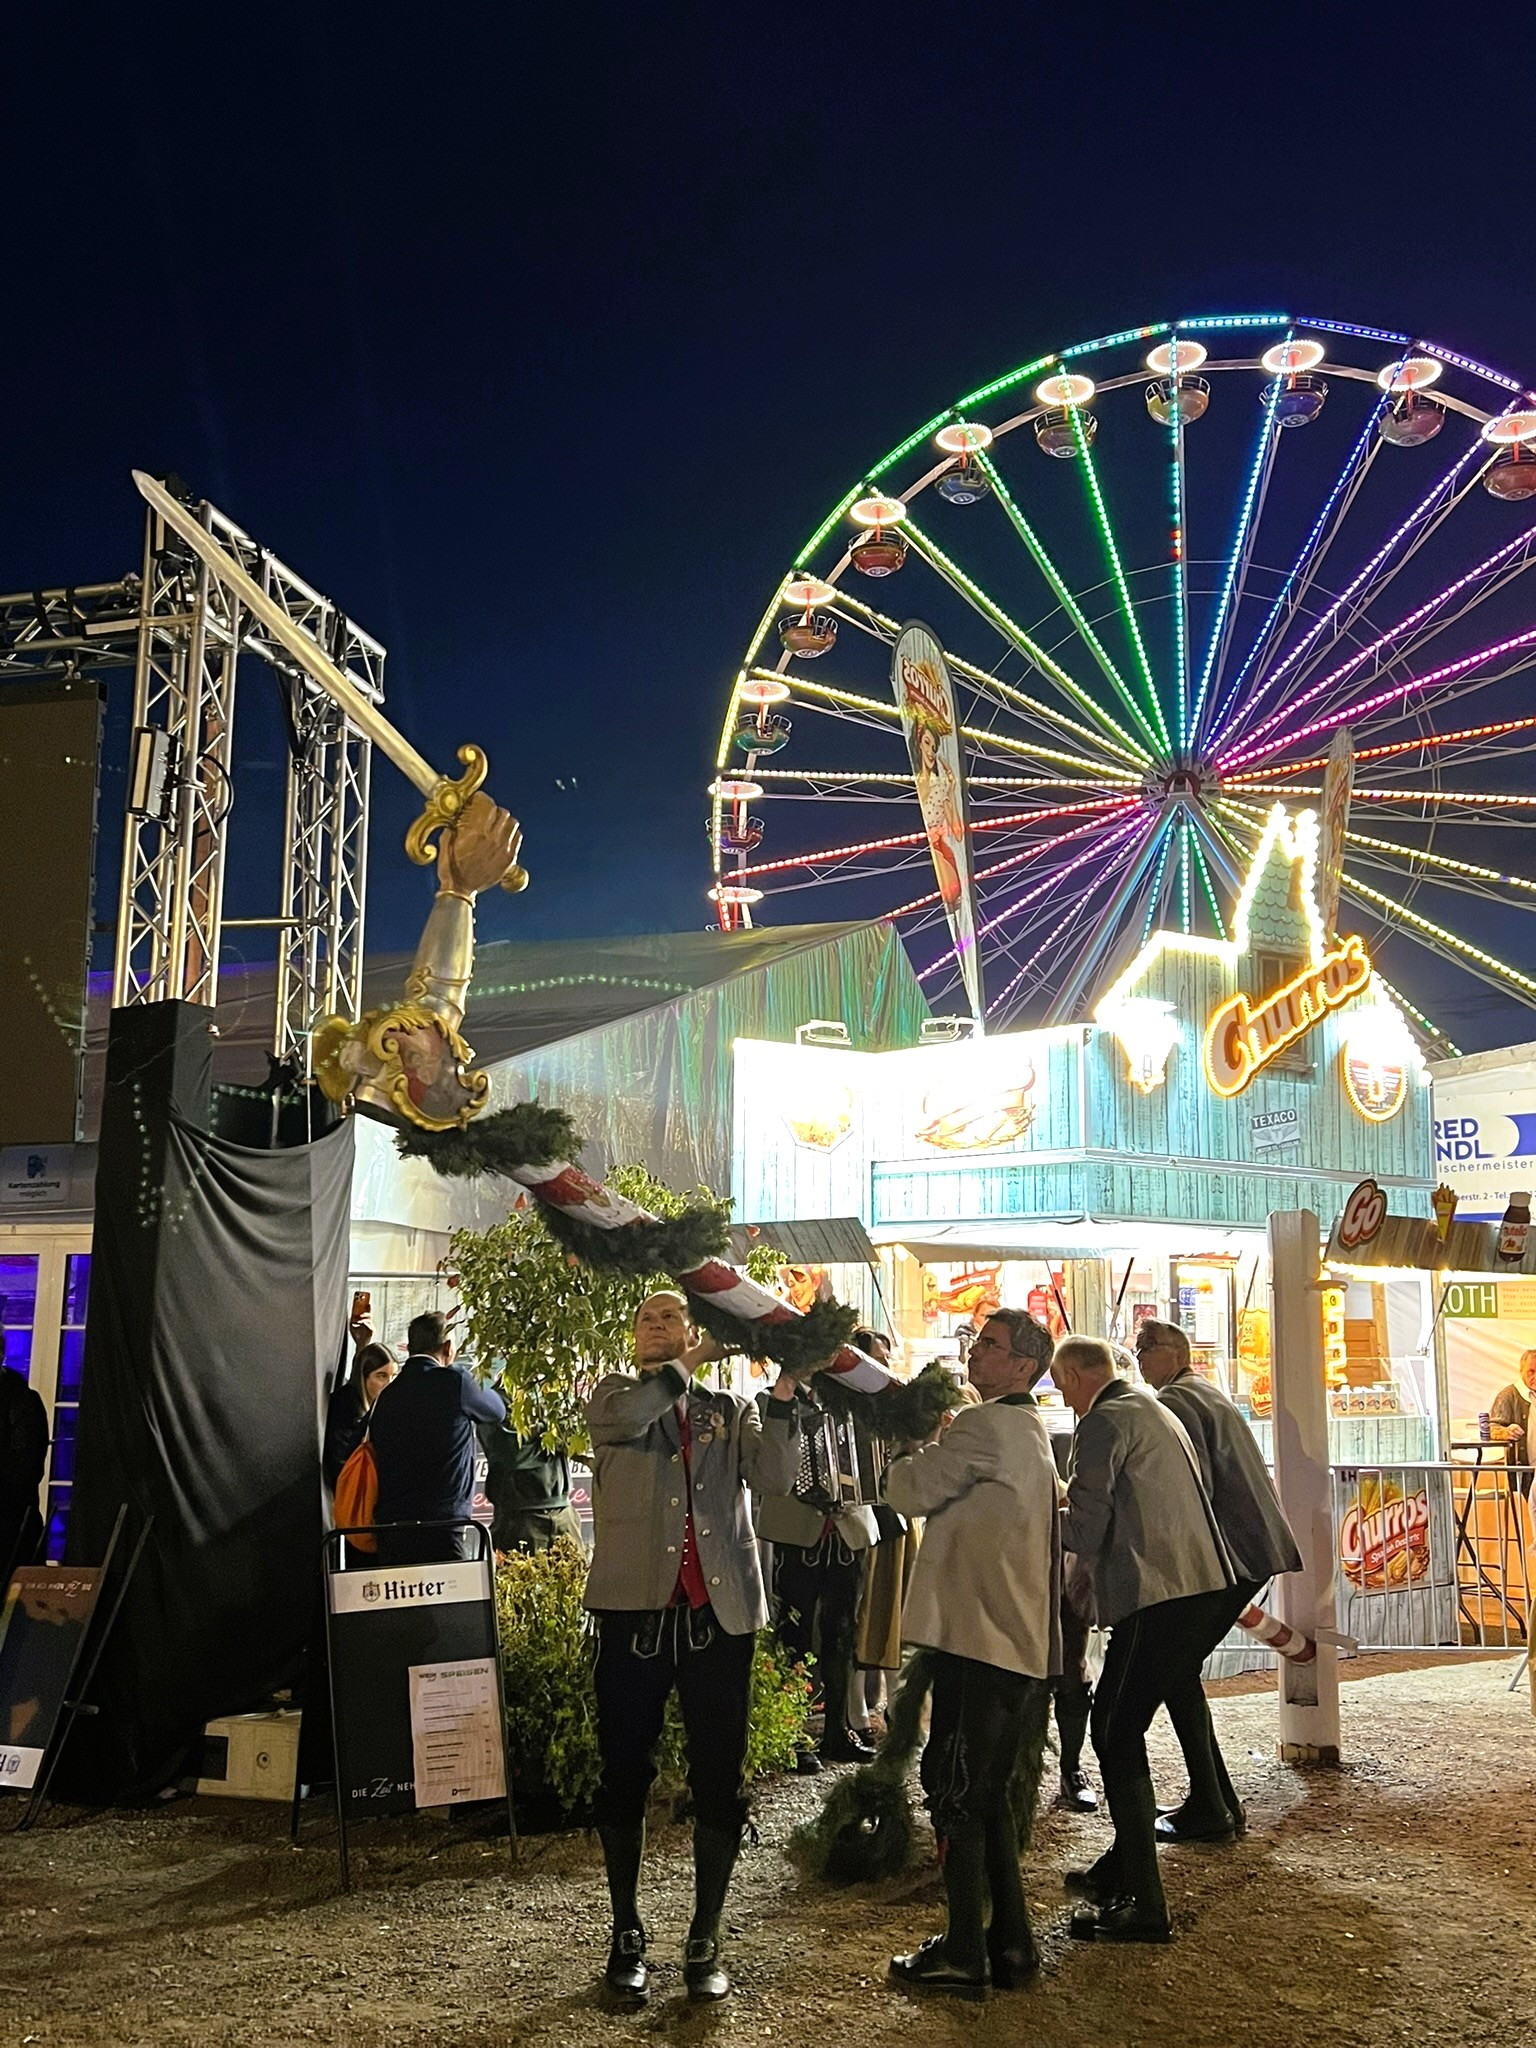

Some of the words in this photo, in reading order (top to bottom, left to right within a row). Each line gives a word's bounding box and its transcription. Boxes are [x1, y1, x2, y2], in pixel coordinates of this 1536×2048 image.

[1252, 1110, 1296, 1128] TEXACO
[1483, 1192, 1489, 1200] 2
[1343, 1185, 1383, 1236] Go
[384, 1580, 445, 1600] Hirter
[351, 1788, 367, 1799] DIE
